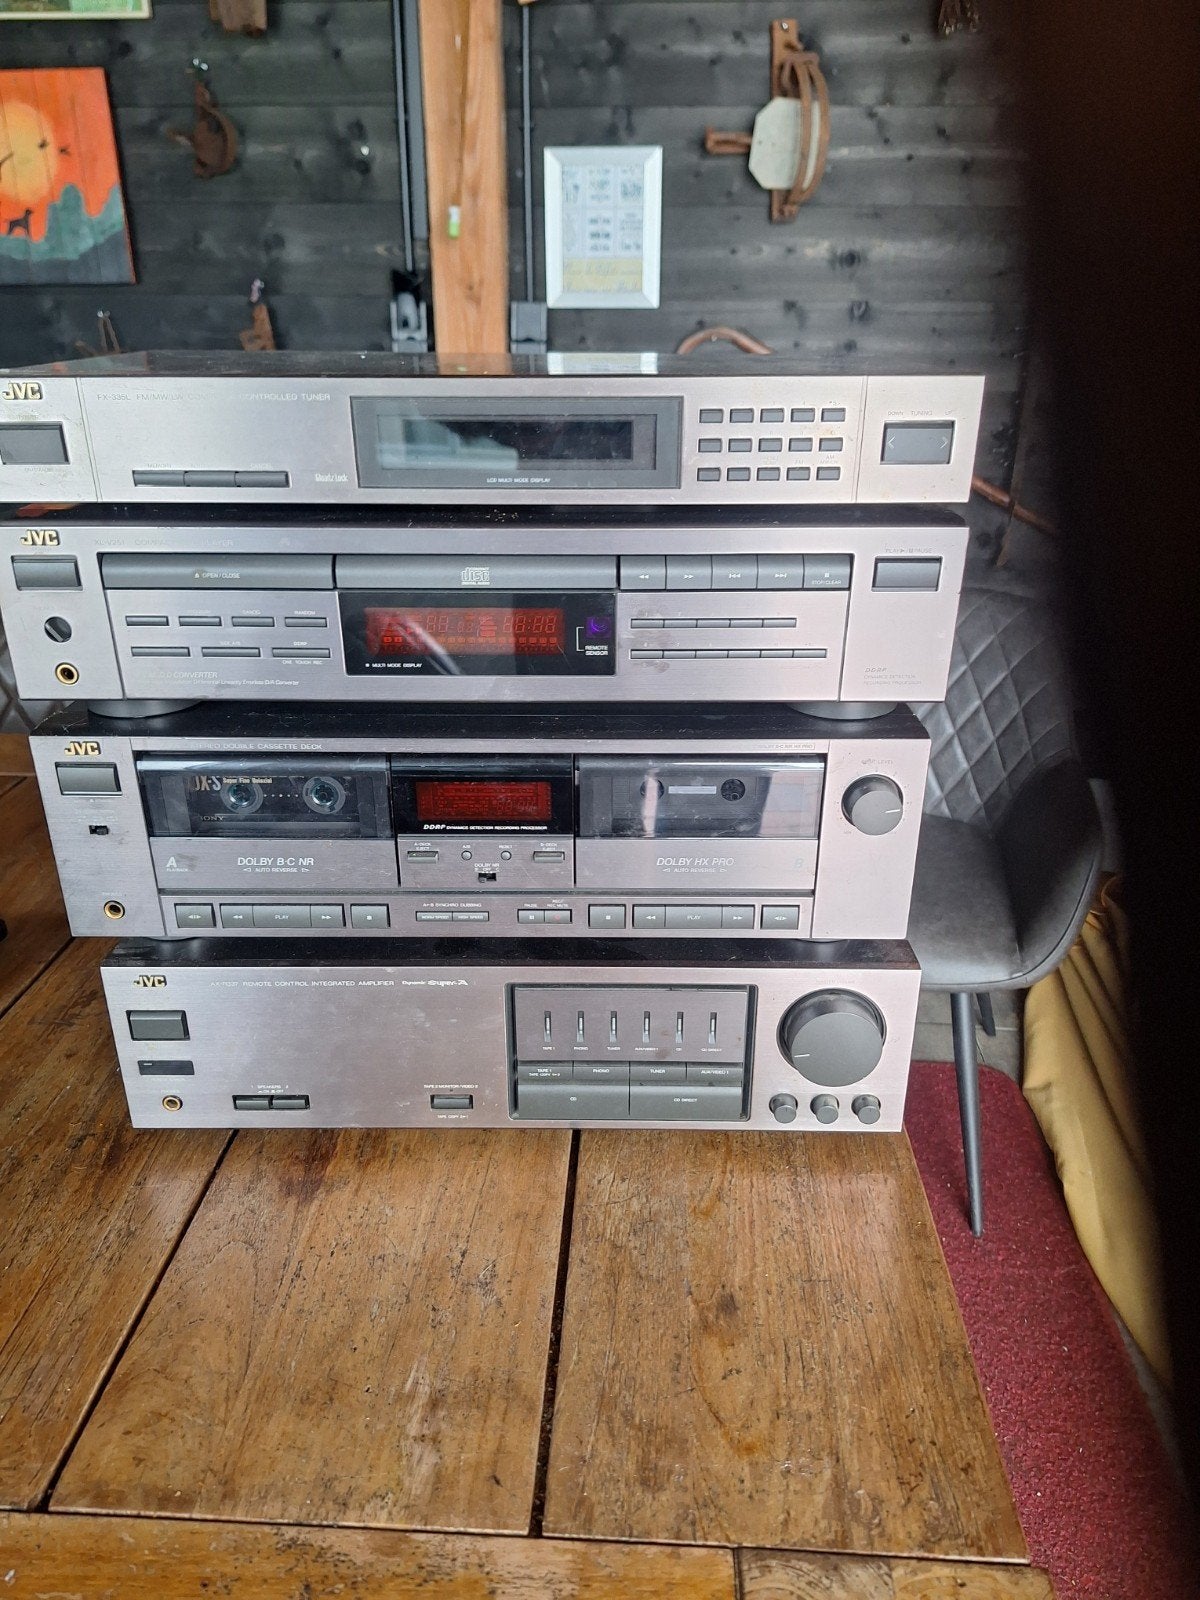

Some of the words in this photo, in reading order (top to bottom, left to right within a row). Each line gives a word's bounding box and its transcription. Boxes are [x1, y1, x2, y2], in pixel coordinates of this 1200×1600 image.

[2, 382, 41, 400] JVC
[301, 392, 332, 402] TUNER
[20, 530, 57, 546] JVC
[64, 742, 99, 755] JVC
[166, 856, 178, 868] A
[237, 857, 273, 866] DOLBY
[299, 857, 314, 866] NR
[657, 857, 690, 866] DOLBY
[694, 857, 709, 866] HX
[711, 857, 734, 866] PRO
[133, 975, 166, 987] JVC
